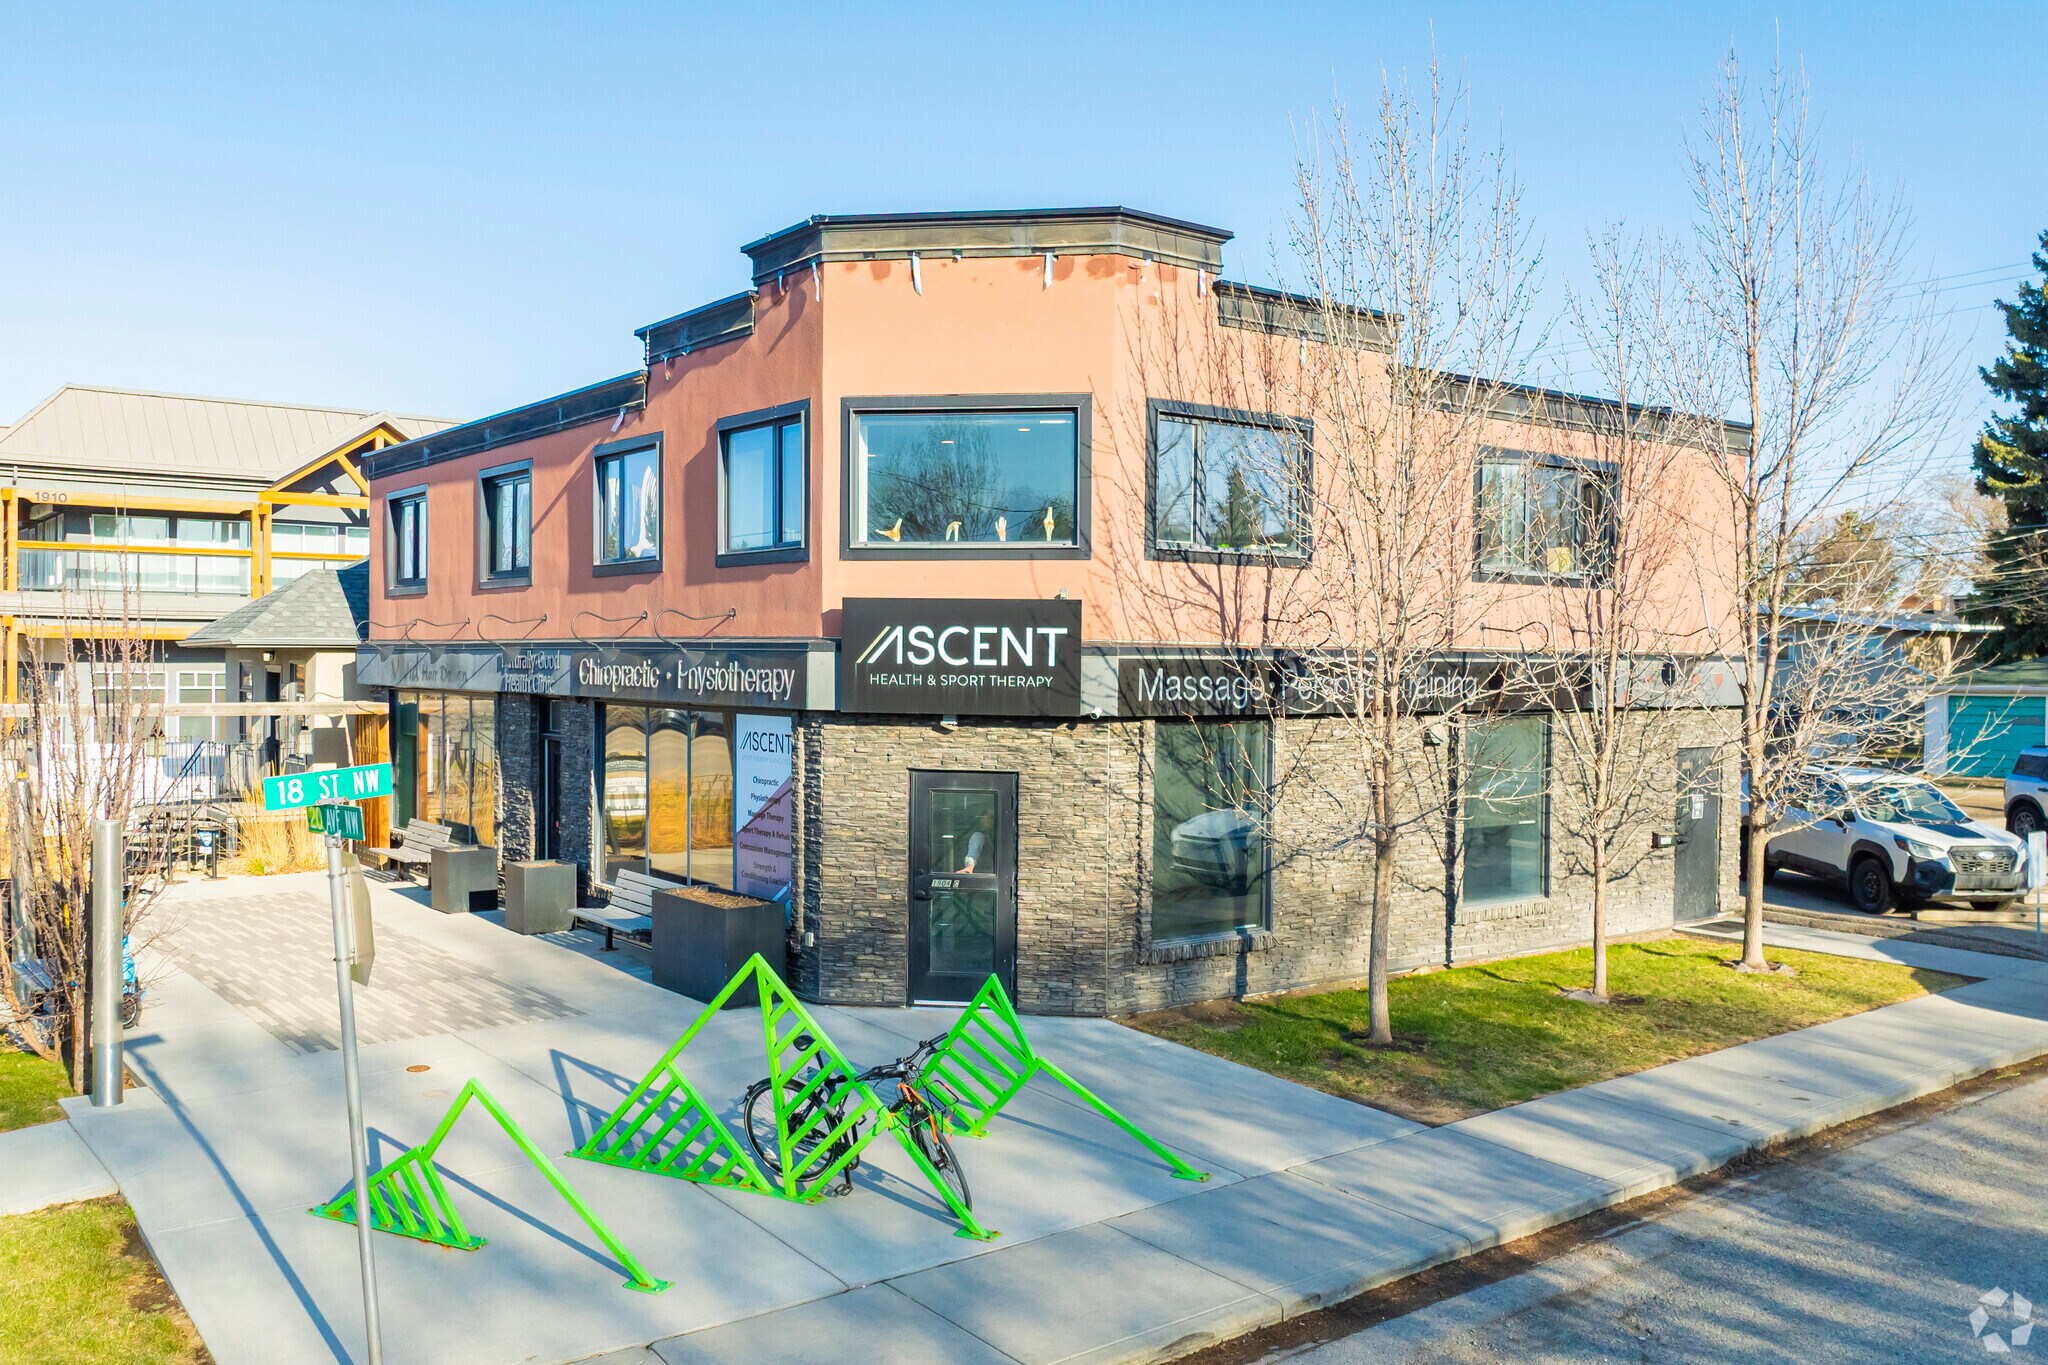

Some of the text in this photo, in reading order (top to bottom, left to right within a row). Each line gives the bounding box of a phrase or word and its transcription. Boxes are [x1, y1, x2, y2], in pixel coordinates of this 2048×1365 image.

[35, 492, 67, 503] 1910
[856, 625, 1068, 667] ASCENT
[501, 650, 560, 673] turally Good
[579, 658, 660, 692] Chiropractic
[870, 673, 1054, 688] HEALTH & SPORT THERAPY
[505, 673, 531, 695] Health
[740, 731, 792, 754] ASCENT
[277, 769, 379, 805] 18 ST NW
[753, 776, 779, 786] Chiropractic
[344, 811, 359, 835] NW
[767, 812, 784, 823] Therapy
[754, 828, 771, 838] Therapy
[776, 832, 790, 840] Rehab
[740, 842, 792, 858] Concussion Managemen
[754, 861, 772, 873] Strength
[742, 870, 768, 884] Conditioning
